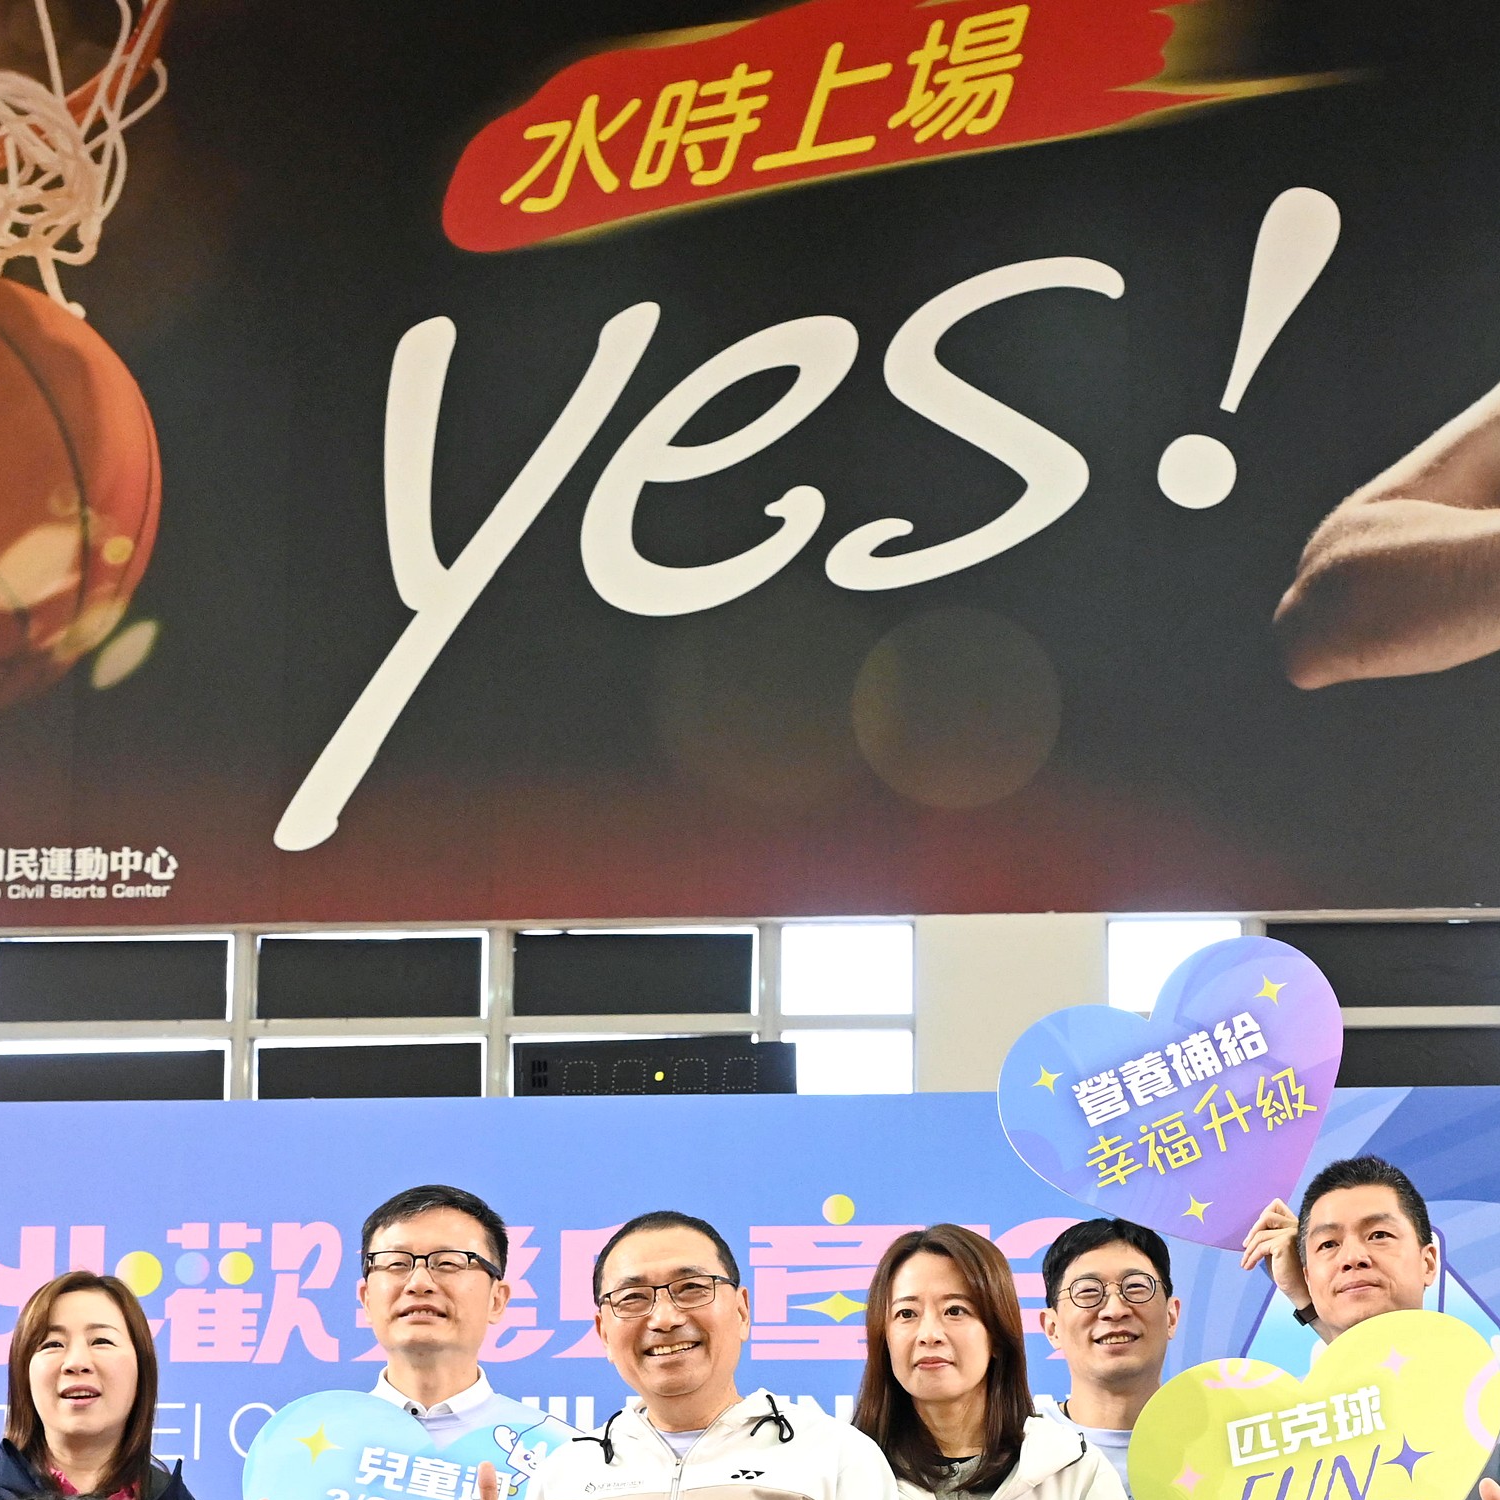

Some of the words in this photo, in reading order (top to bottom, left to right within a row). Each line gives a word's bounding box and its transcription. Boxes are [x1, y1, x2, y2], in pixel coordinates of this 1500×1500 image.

[500, 4, 1031, 214] 水時上場
[273, 186, 1342, 852] yes!
[7, 884, 45, 900] Civil
[50, 884, 107, 901] Sports
[112, 883, 171, 899] Center
[1072, 1011, 1270, 1128] 營養補給
[1085, 1066, 1318, 1189] 幸福升級
[1226, 1384, 1386, 1467] 匹克球
